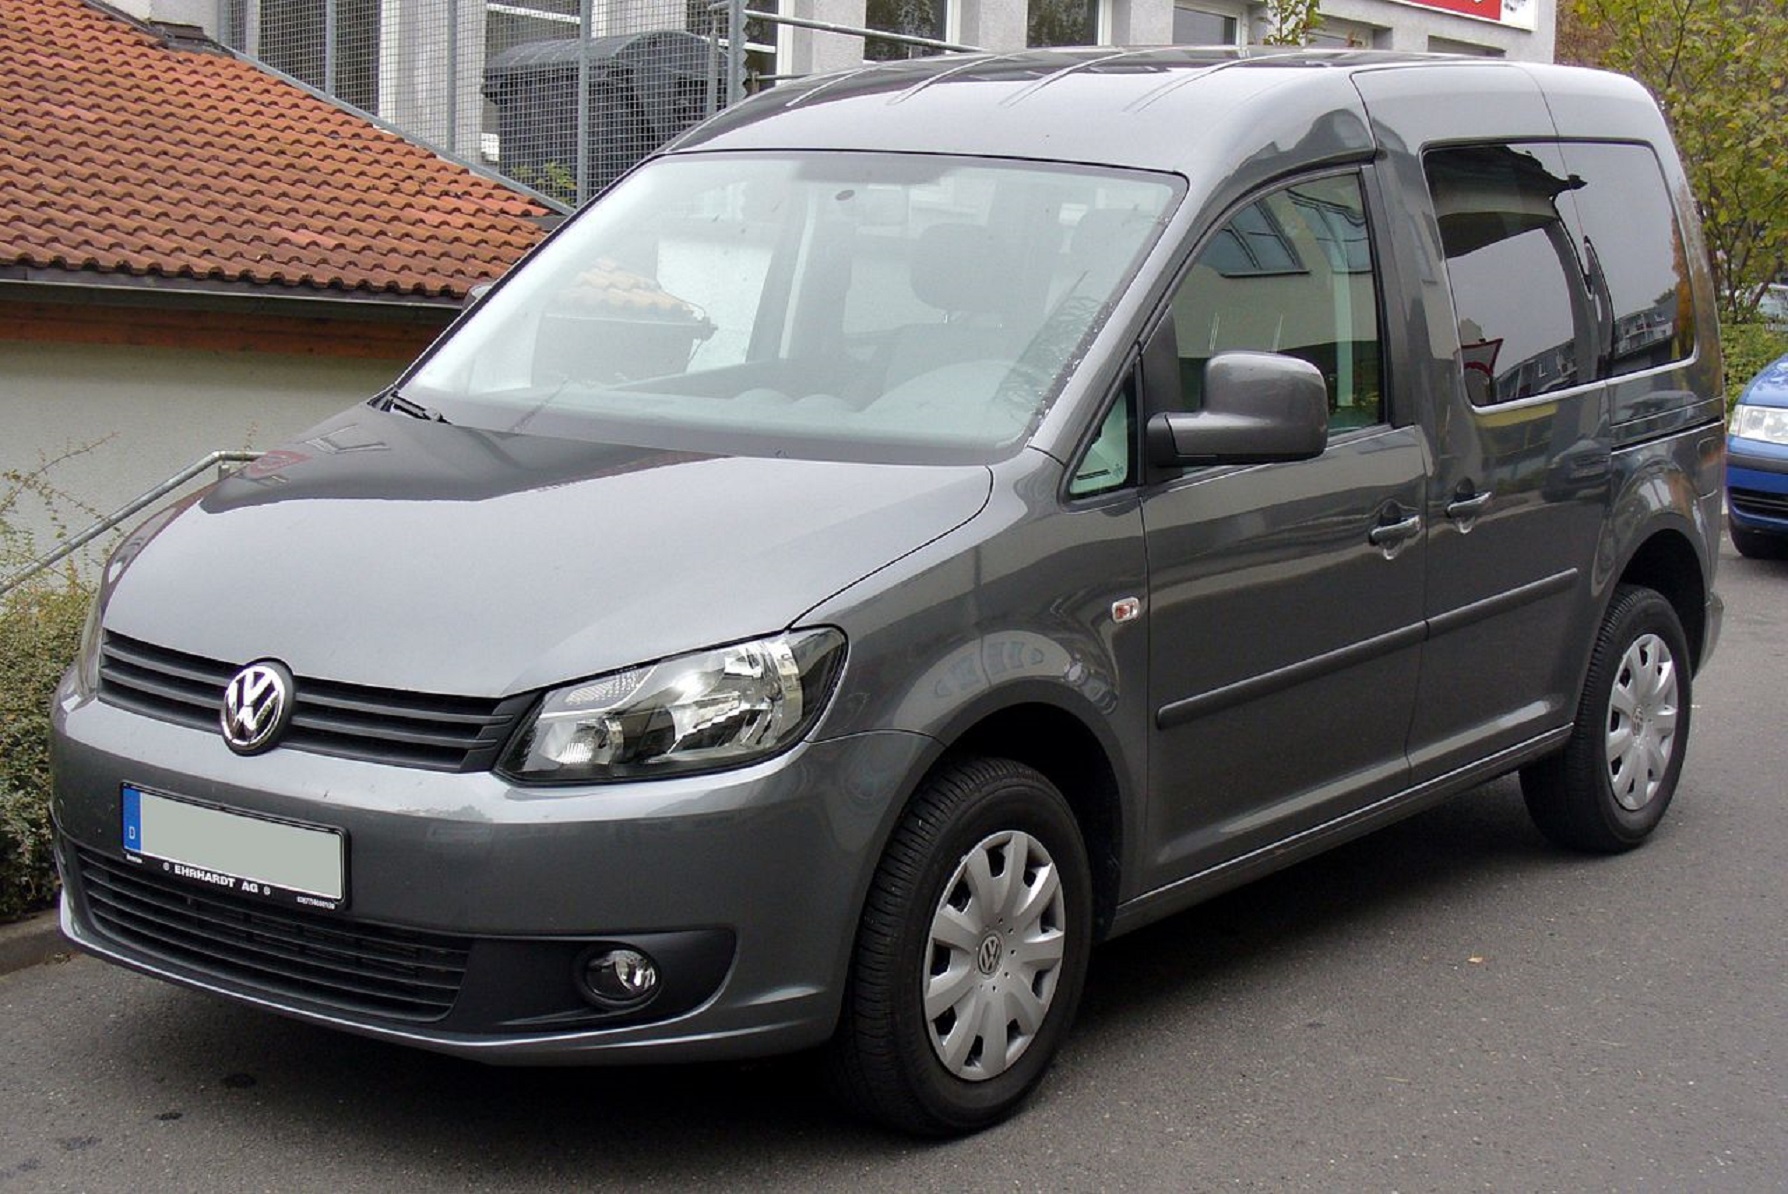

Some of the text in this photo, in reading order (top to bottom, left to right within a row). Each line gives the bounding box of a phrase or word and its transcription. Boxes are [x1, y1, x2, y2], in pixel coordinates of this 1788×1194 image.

[222, 665, 284, 746] VW
[128, 826, 136, 840] D
[174, 864, 259, 894] EHRHARDT AG
